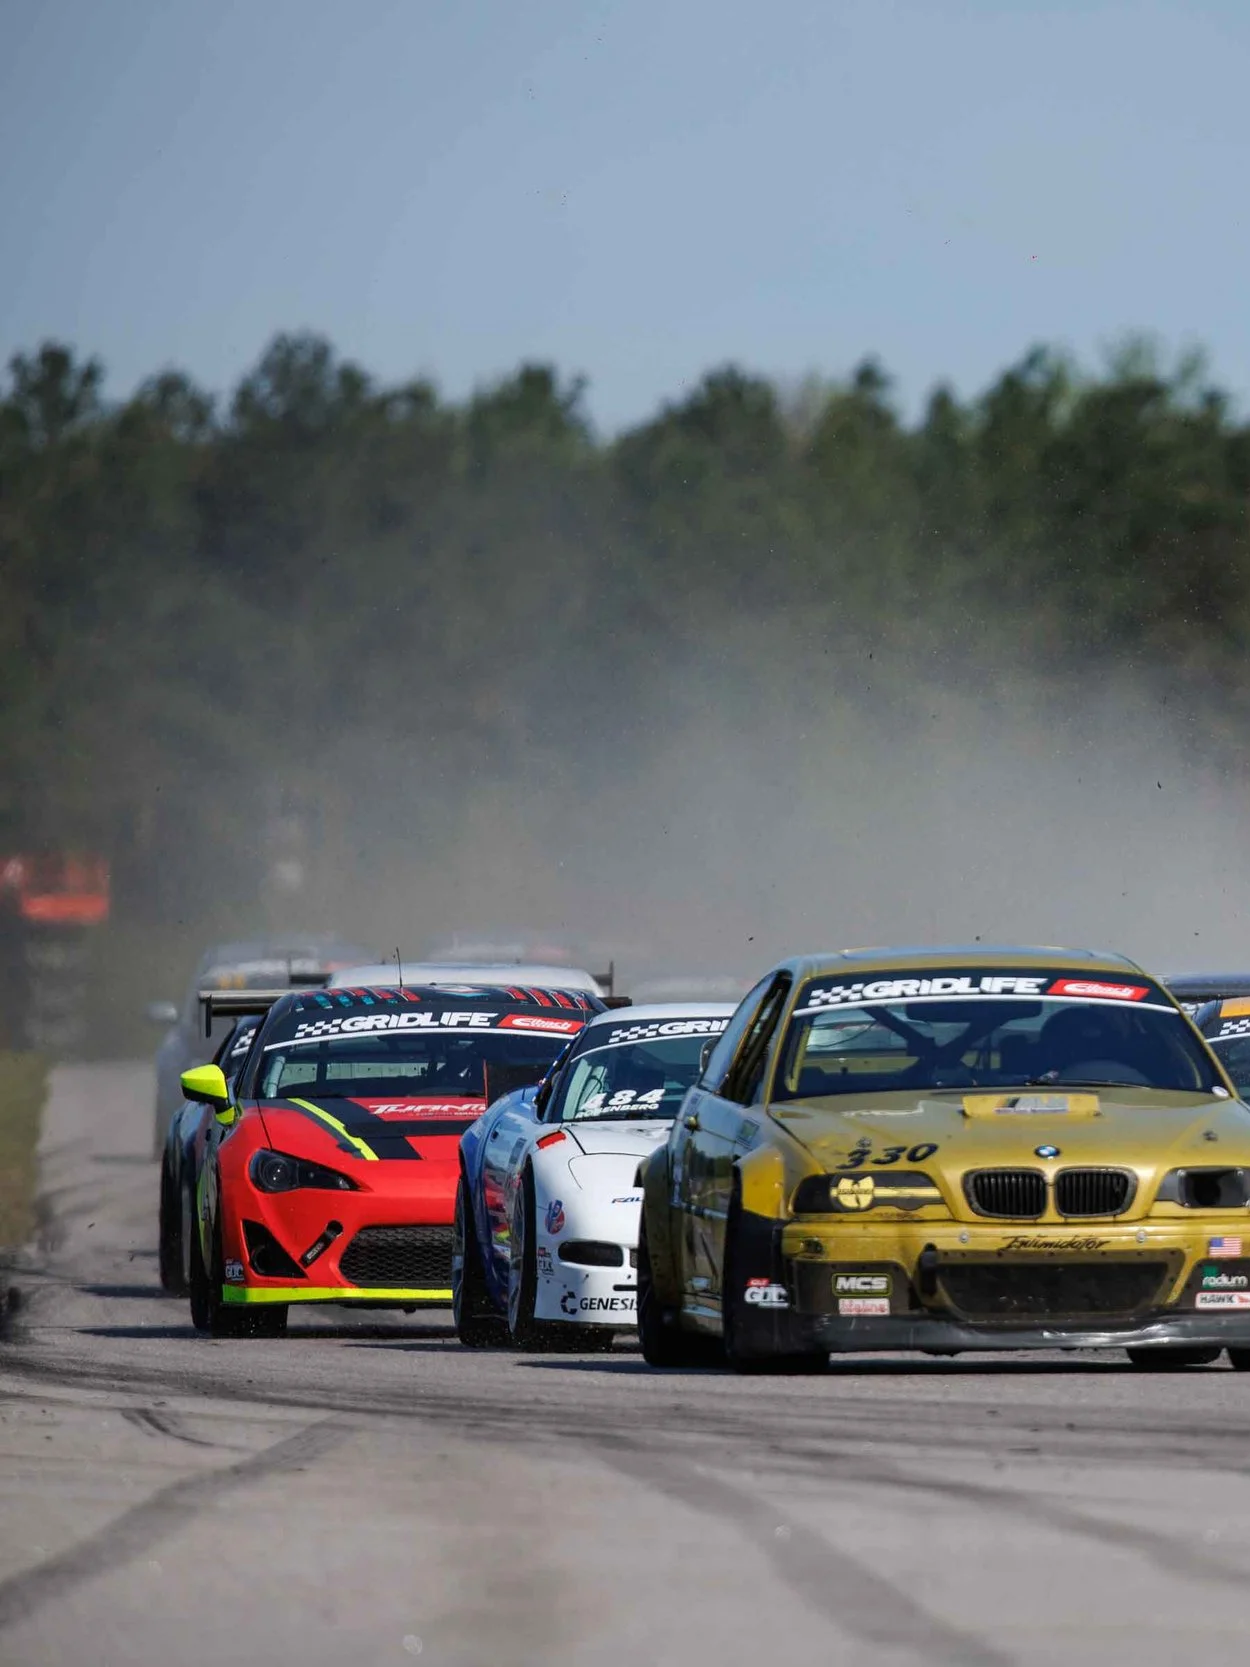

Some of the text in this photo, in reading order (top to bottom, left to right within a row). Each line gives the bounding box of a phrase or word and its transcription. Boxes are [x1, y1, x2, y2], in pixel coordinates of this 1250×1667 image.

[862, 977, 1048, 997] GRIDLIFE
[341, 1012, 499, 1031] GRIDLIFE
[580, 1088, 666, 1111] 484
[837, 1143, 939, 1169] 330
[836, 1276, 889, 1290] MCS
[1202, 1273, 1248, 1287] radium
[1200, 1294, 1235, 1303] HAWK
